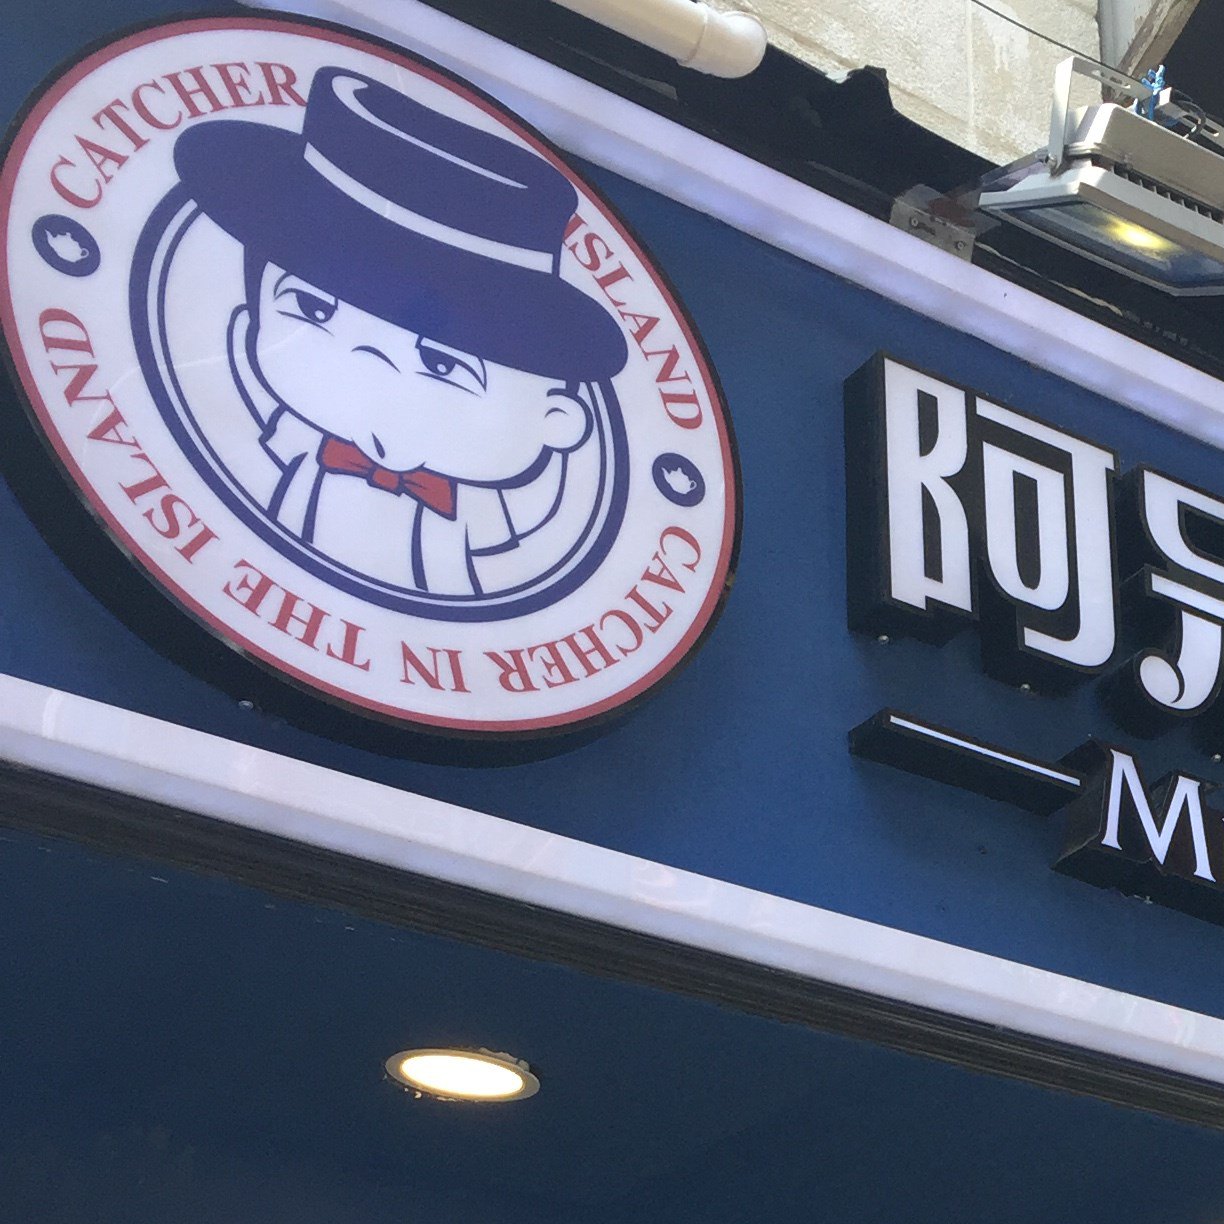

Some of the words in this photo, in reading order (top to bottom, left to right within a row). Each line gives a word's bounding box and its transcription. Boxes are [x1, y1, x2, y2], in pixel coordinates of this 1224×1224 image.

[48, 61, 308, 210] CATCHER
[562, 212, 704, 431] ISLAND
[38, 307, 222, 565] ISLAND
[222, 557, 372, 674] THE
[400, 641, 470, 694] IN
[484, 524, 702, 694] CATCHER
